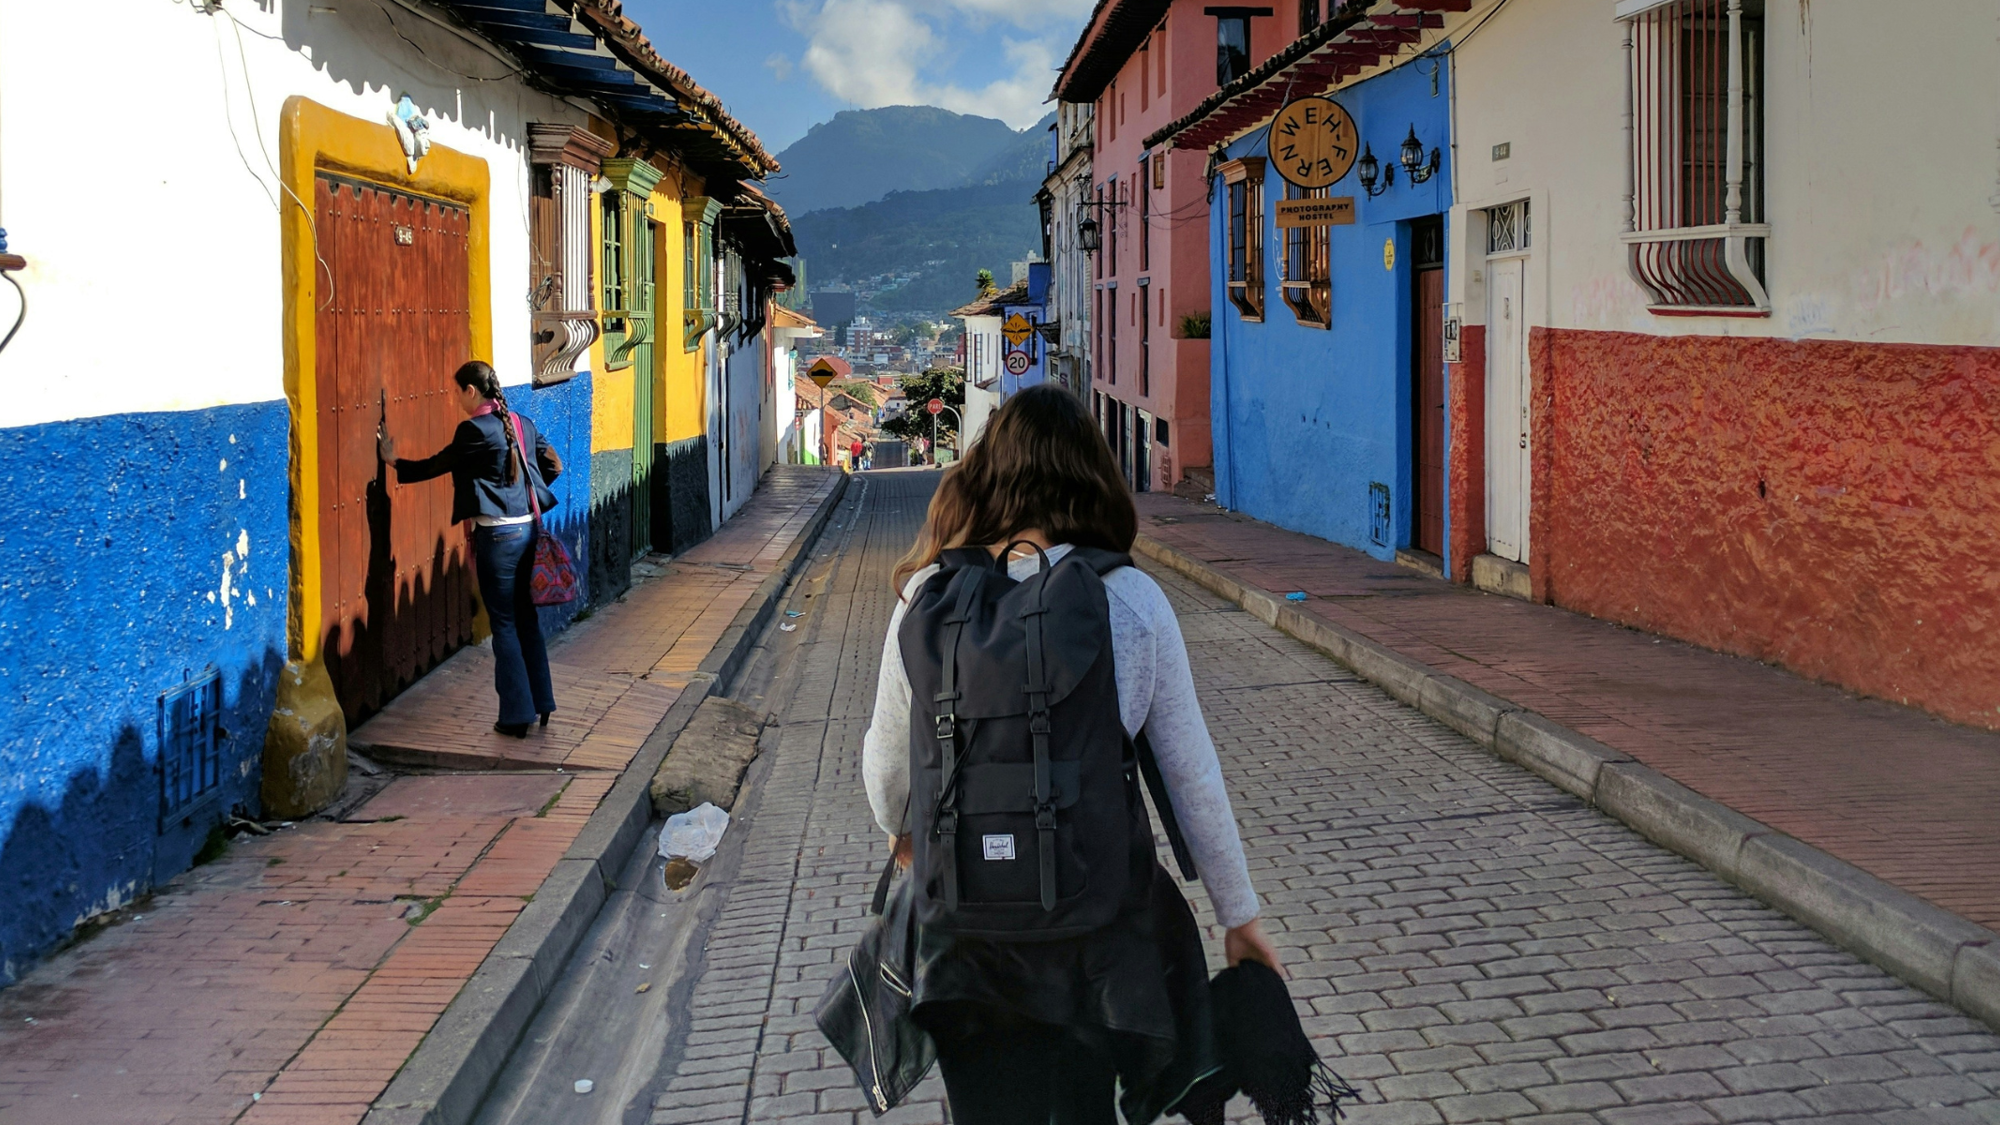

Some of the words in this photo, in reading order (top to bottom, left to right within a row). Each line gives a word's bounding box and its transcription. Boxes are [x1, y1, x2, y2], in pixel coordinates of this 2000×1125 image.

[1281, 203, 1350, 213] PHOTOGRAPHY
[1299, 213, 1334, 221] HOSTEL
[1009, 357, 1026, 369] 20
